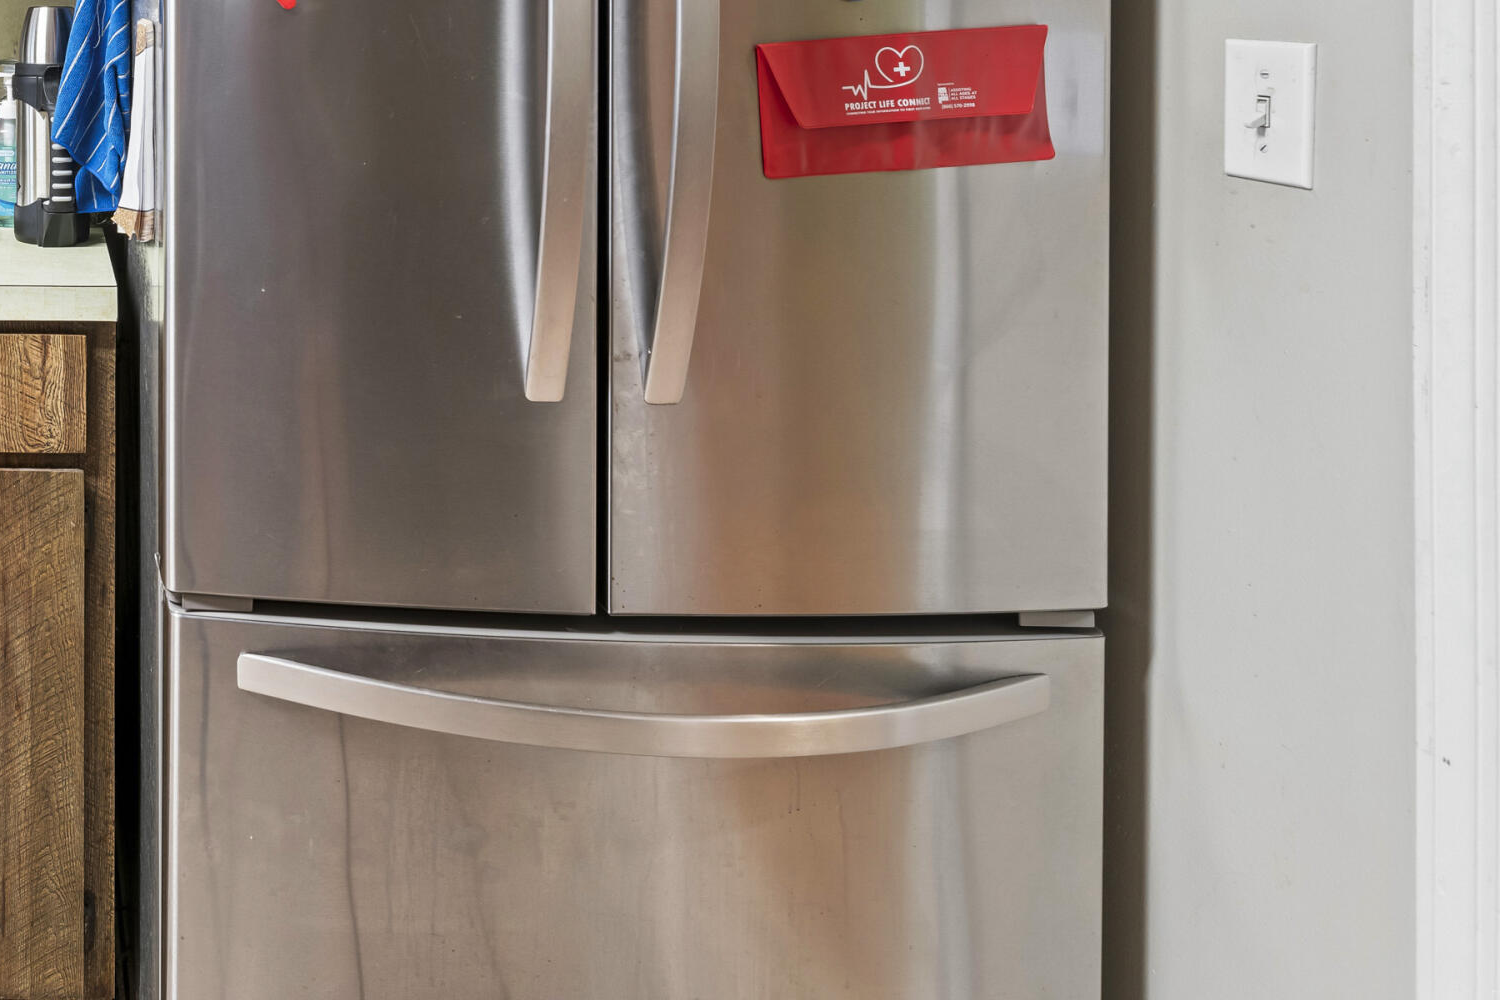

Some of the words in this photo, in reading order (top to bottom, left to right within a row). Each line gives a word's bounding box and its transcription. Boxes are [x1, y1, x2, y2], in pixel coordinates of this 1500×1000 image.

[844, 101, 877, 111] PROJECT
[879, 100, 895, 108] LIFE
[897, 97, 931, 107] CONNECT
